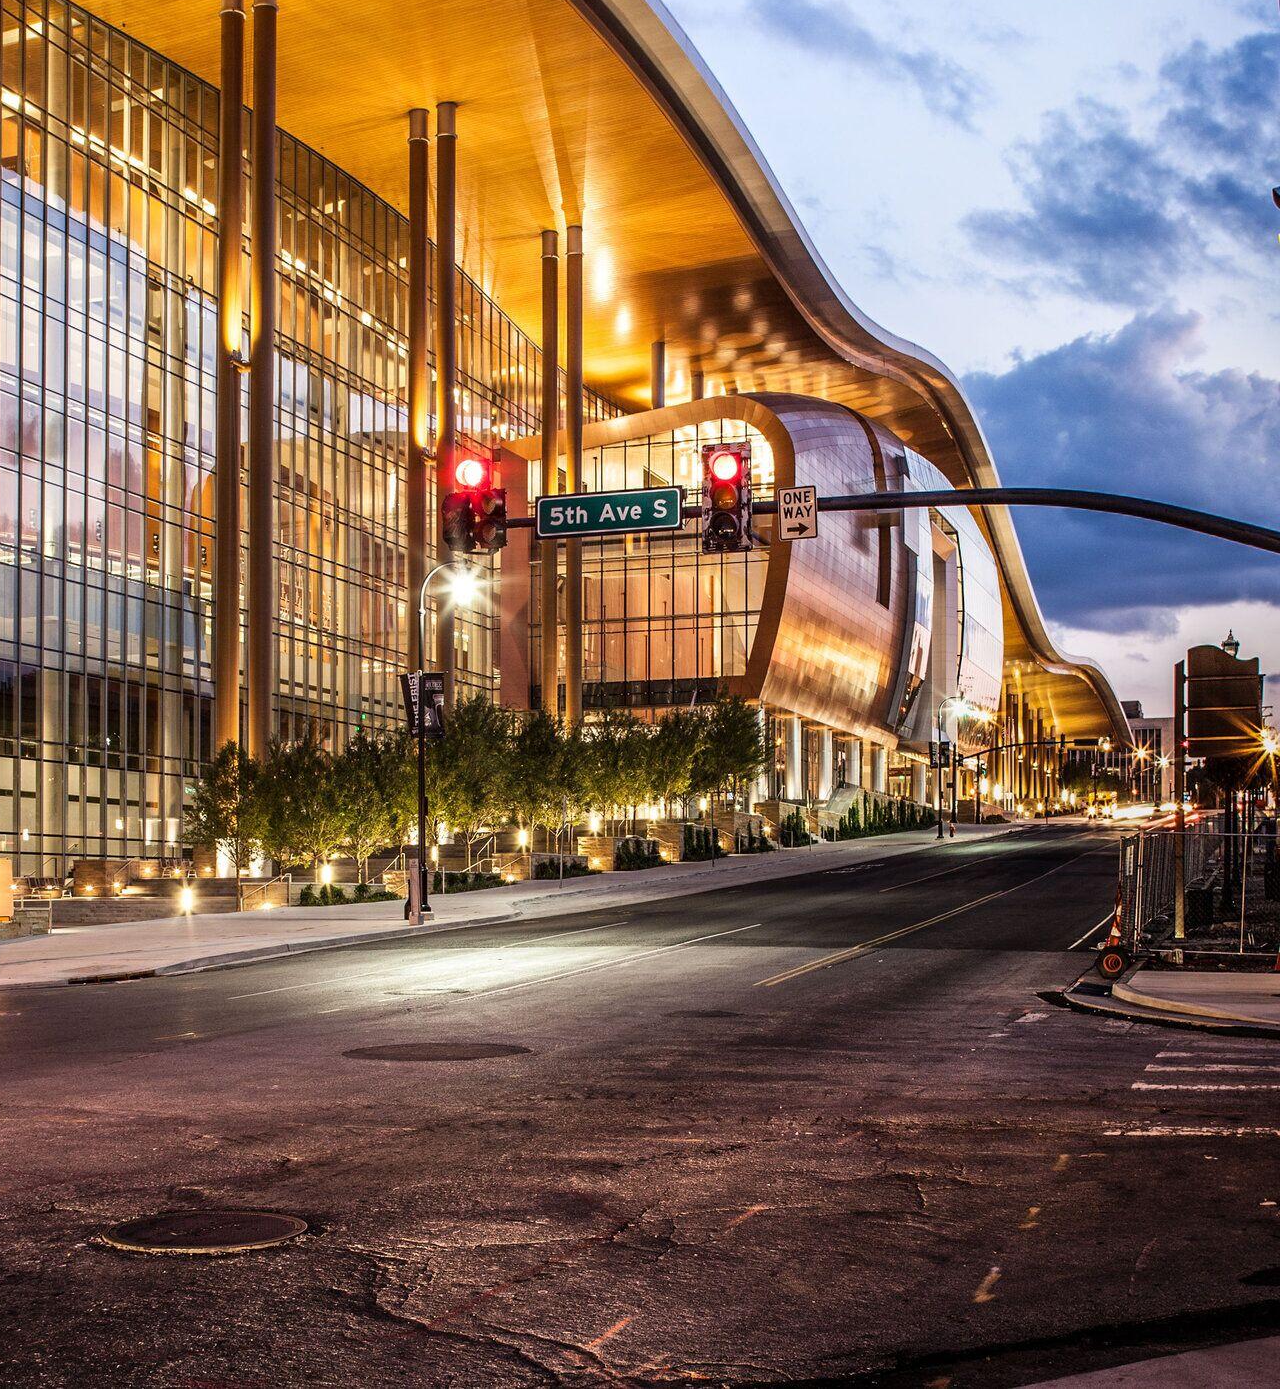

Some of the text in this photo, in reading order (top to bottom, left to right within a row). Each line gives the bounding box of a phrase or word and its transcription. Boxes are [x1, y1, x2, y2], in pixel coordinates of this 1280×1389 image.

[783, 490, 811, 505] ONE
[550, 499, 668, 526] 5th Ave S
[783, 505, 813, 519] WAY
